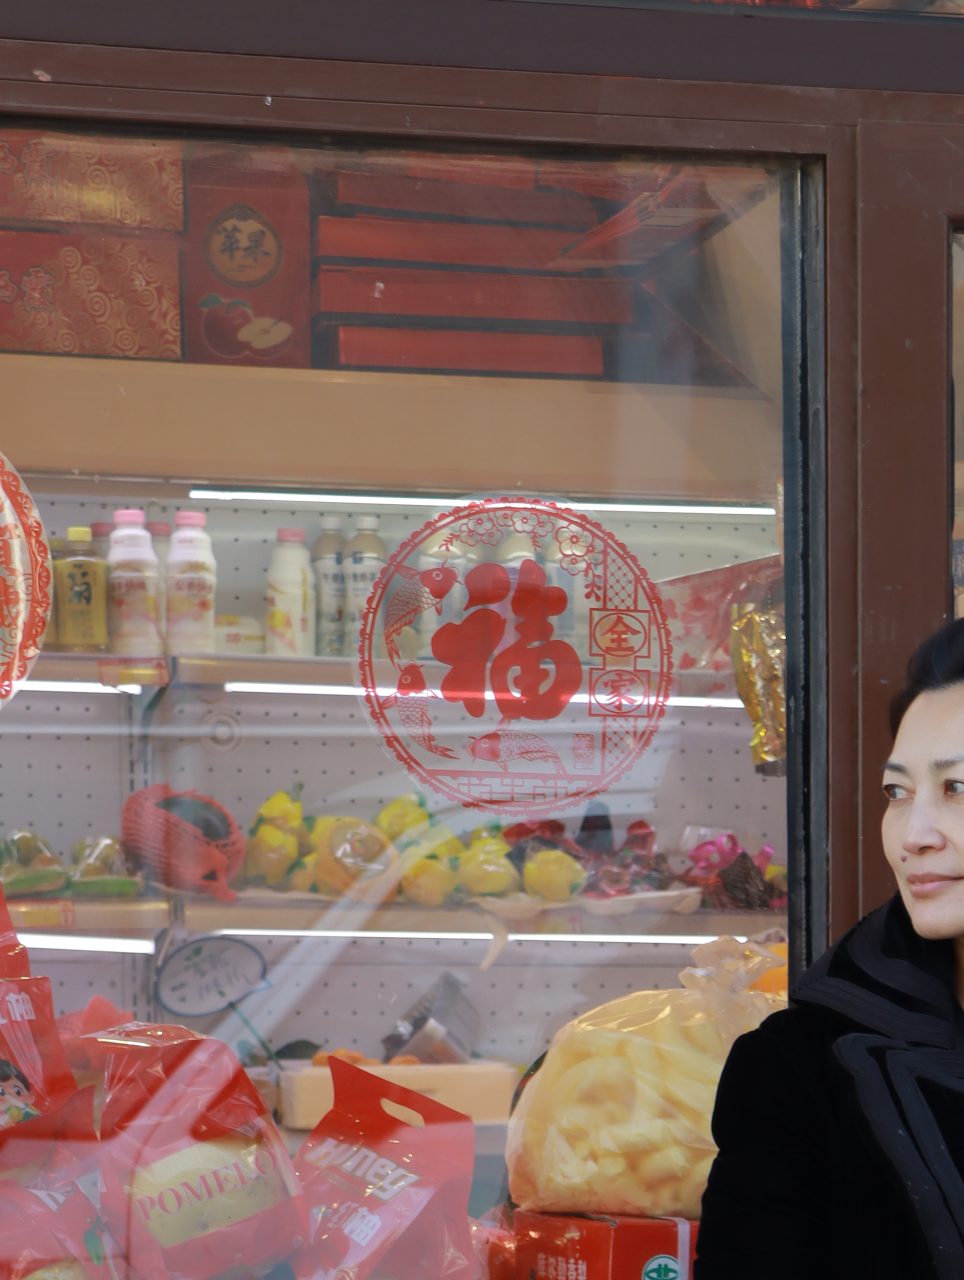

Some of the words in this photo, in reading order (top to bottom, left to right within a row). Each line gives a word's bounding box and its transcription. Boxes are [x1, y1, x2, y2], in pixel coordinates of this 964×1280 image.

[216, 225, 272, 262] 苹果
[431, 558, 584, 721] 福
[134, 1147, 278, 1221] POMELO
